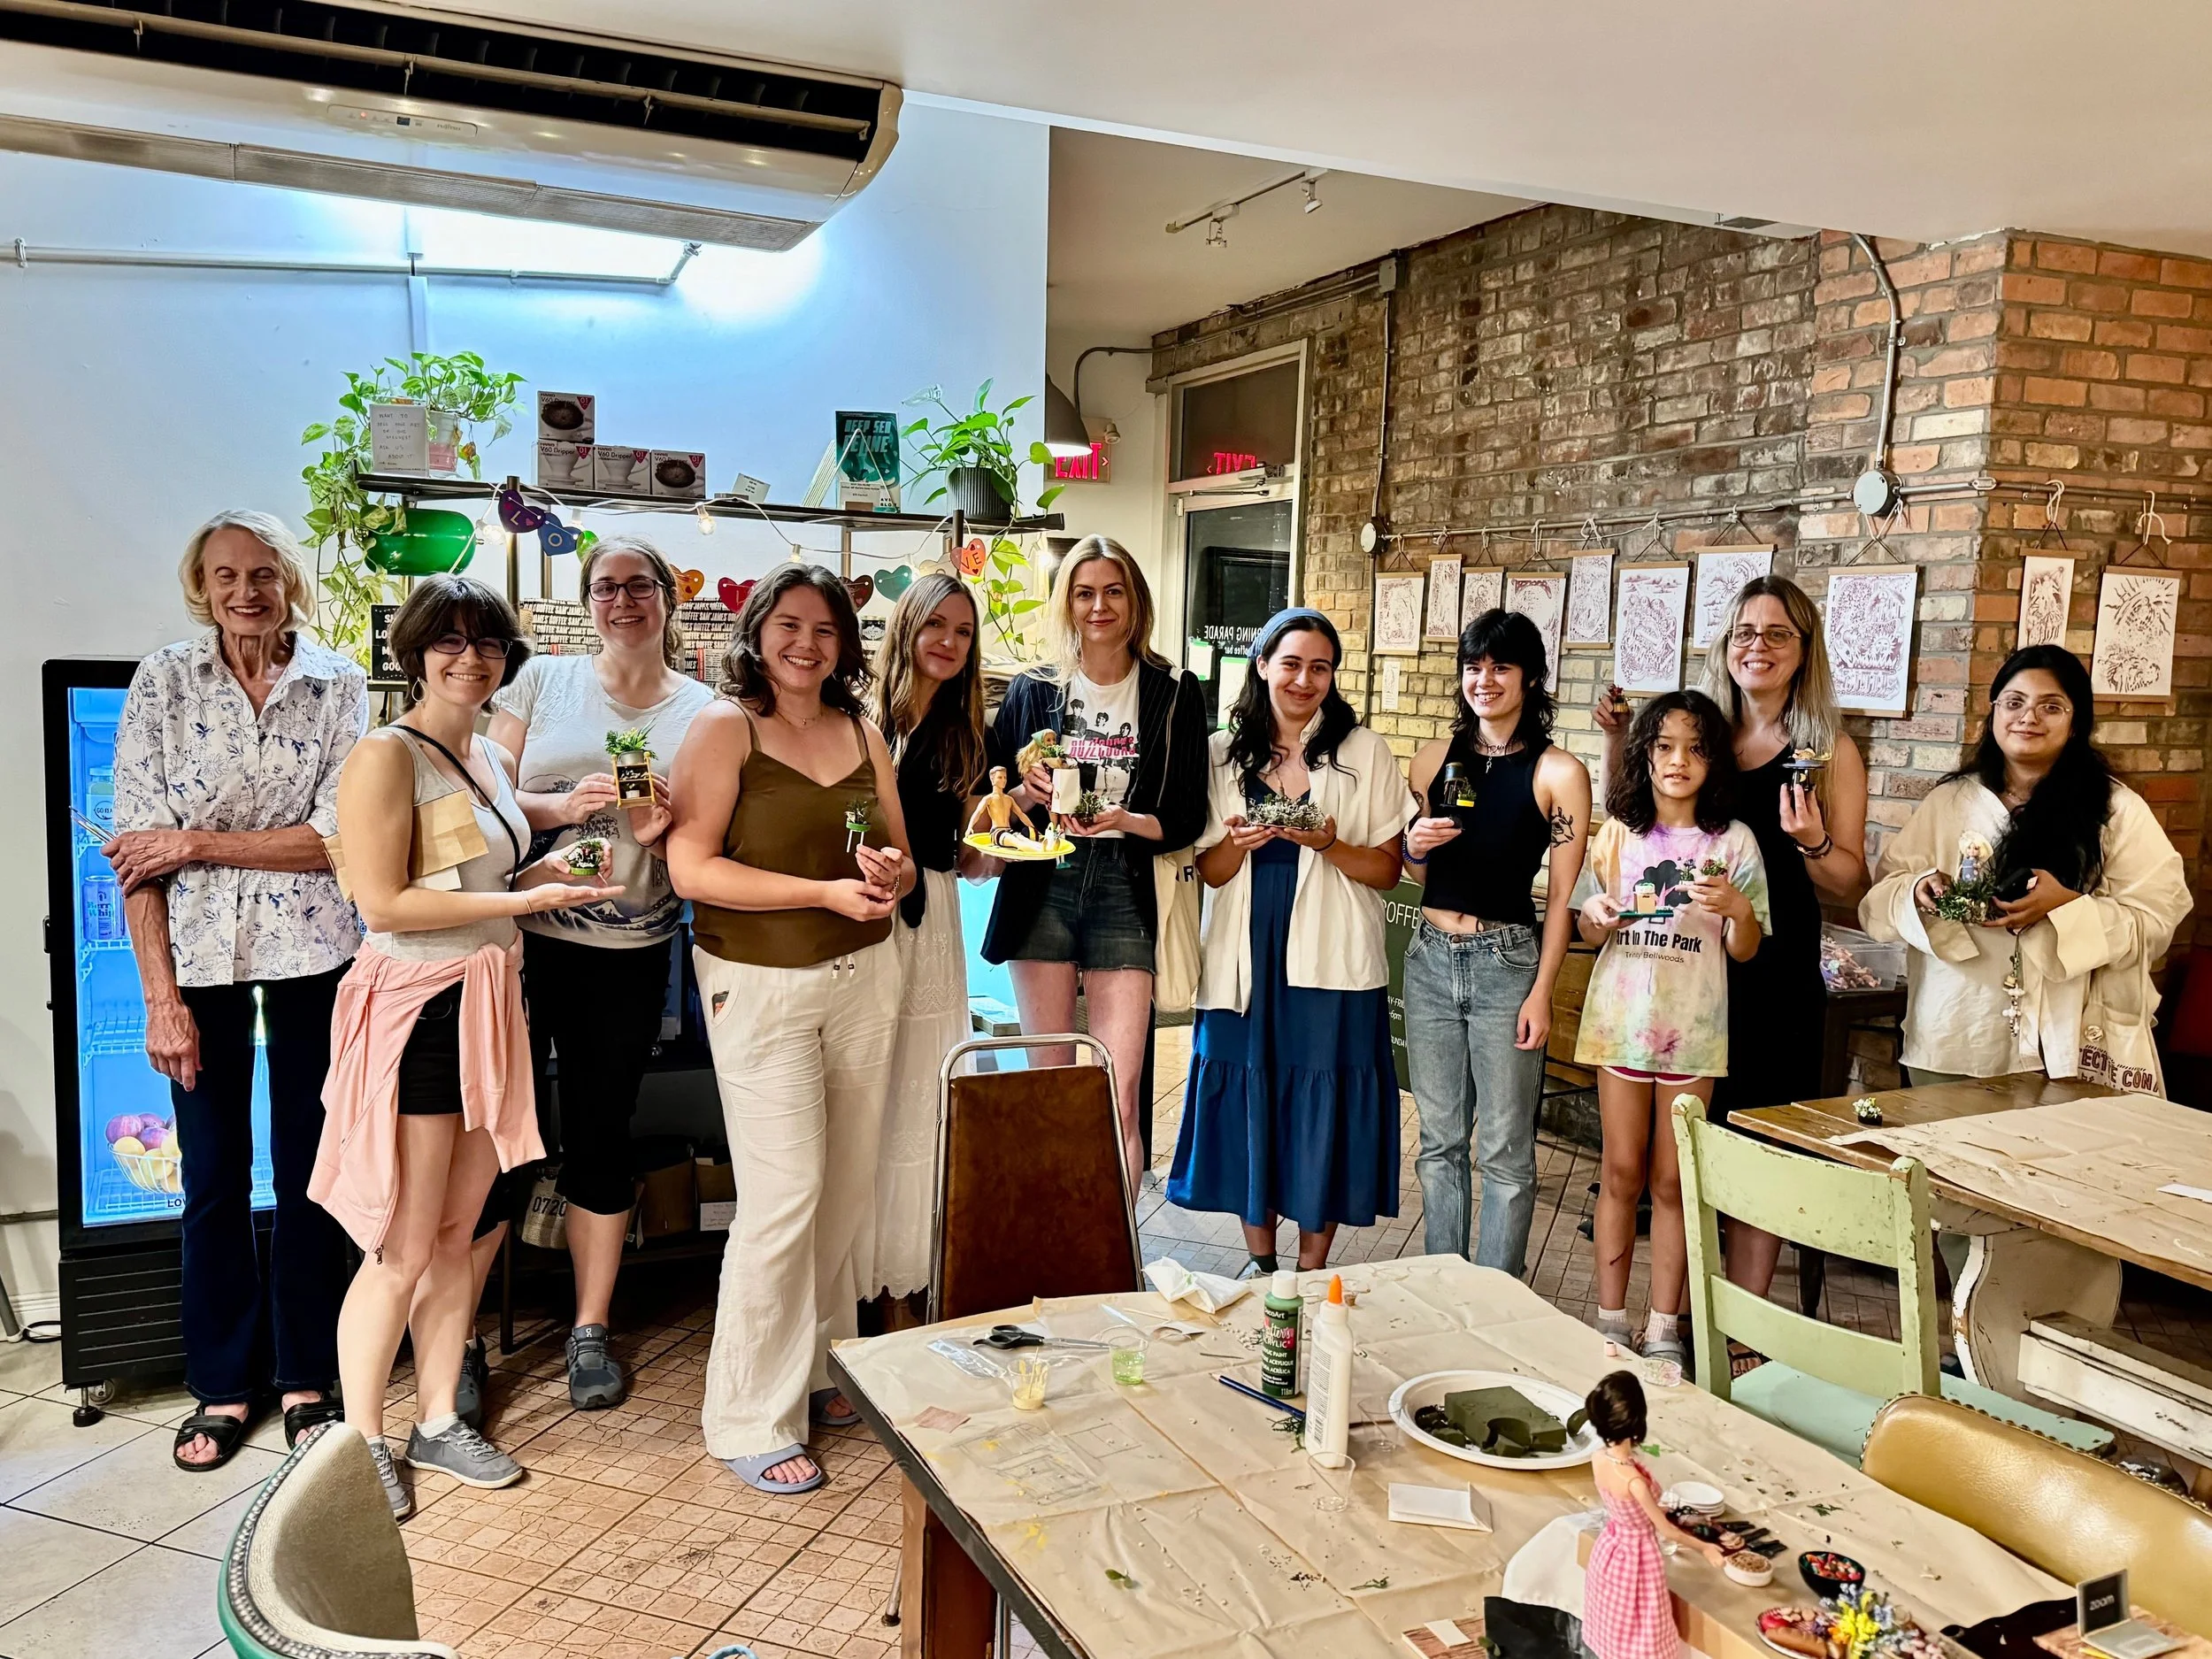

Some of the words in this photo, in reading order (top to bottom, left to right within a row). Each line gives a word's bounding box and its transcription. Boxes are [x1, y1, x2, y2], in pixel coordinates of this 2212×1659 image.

[1056, 442, 1102, 480] EXIT
[510, 511, 521, 526] L
[549, 533, 563, 547] O
[1632, 930, 1640, 945] In
[1644, 930, 1668, 947] The
[1672, 933, 1702, 953] Park
[1643, 951, 1685, 963] Bellwoods
[2089, 1594, 2115, 1611] zoom
